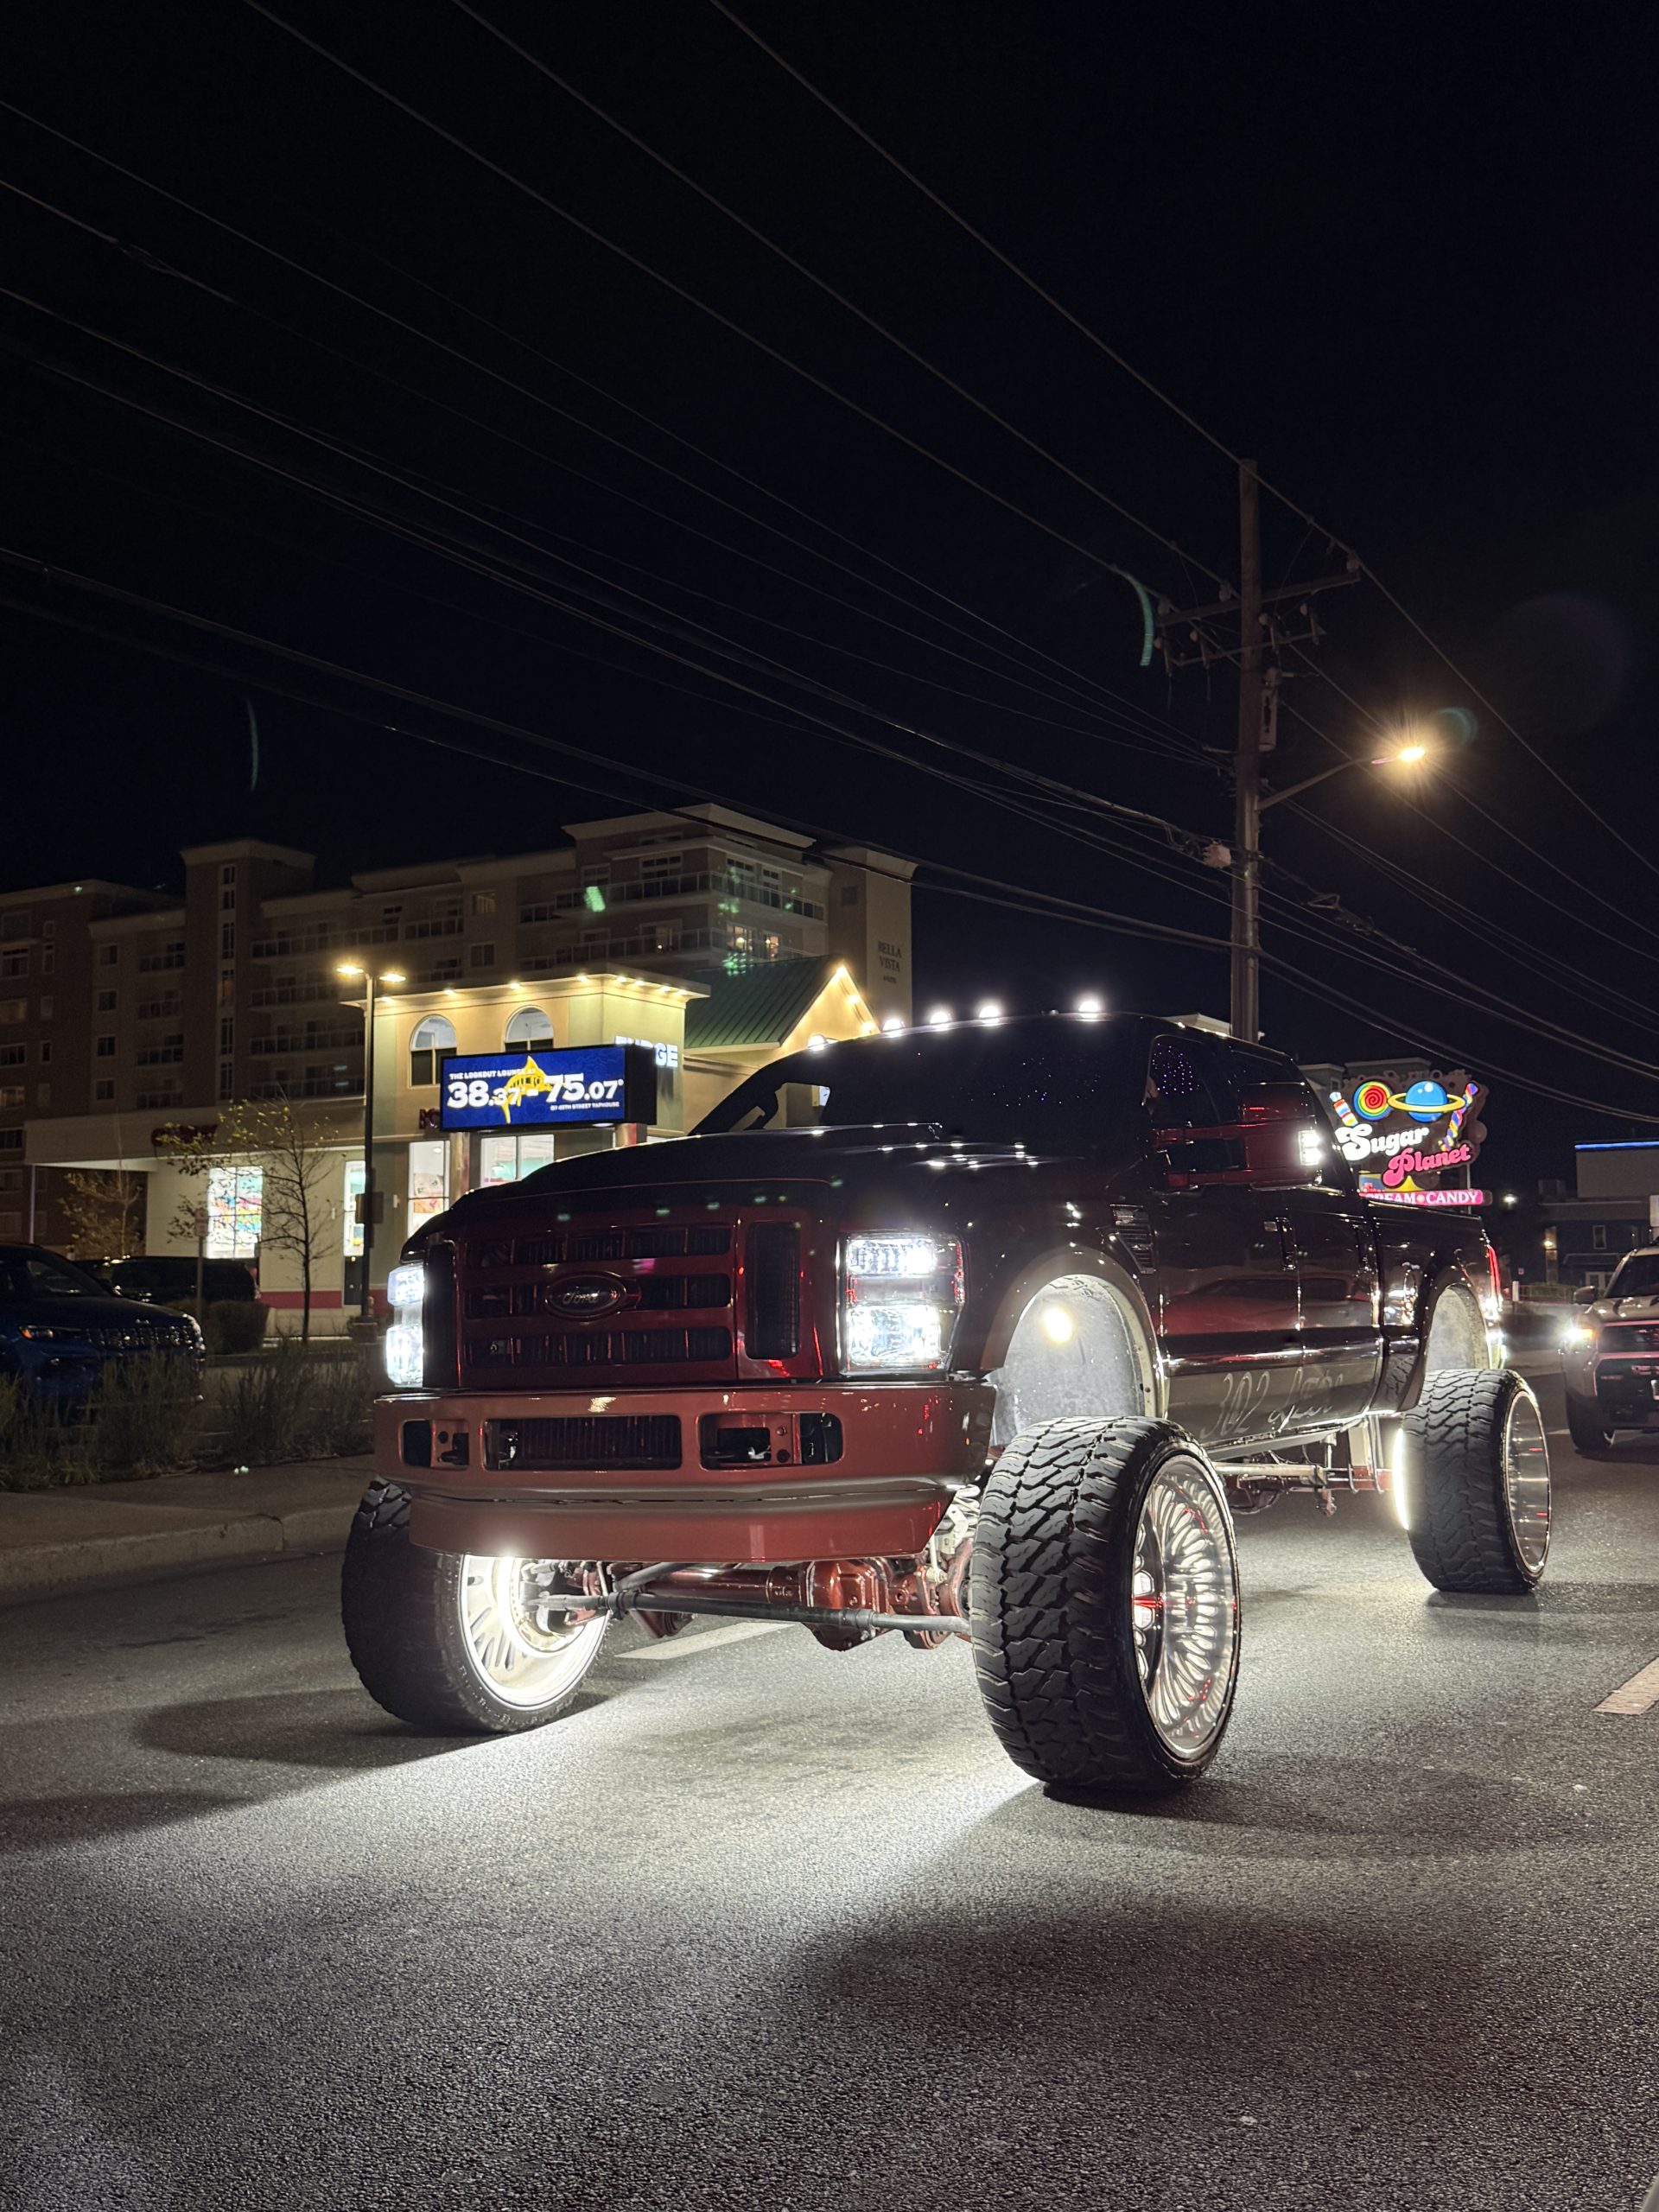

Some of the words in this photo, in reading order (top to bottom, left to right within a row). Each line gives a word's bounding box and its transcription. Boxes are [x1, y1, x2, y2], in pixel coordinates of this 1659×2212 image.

[879, 955, 900, 972] VISTA
[464, 1070, 497, 1080] LOOKOUT
[497, 1068, 524, 1077] LOUNGE
[1334, 1123, 1430, 1161] Sugar
[1381, 1143, 1471, 1187] Planet
[1425, 1191, 1478, 1205] CANDY
